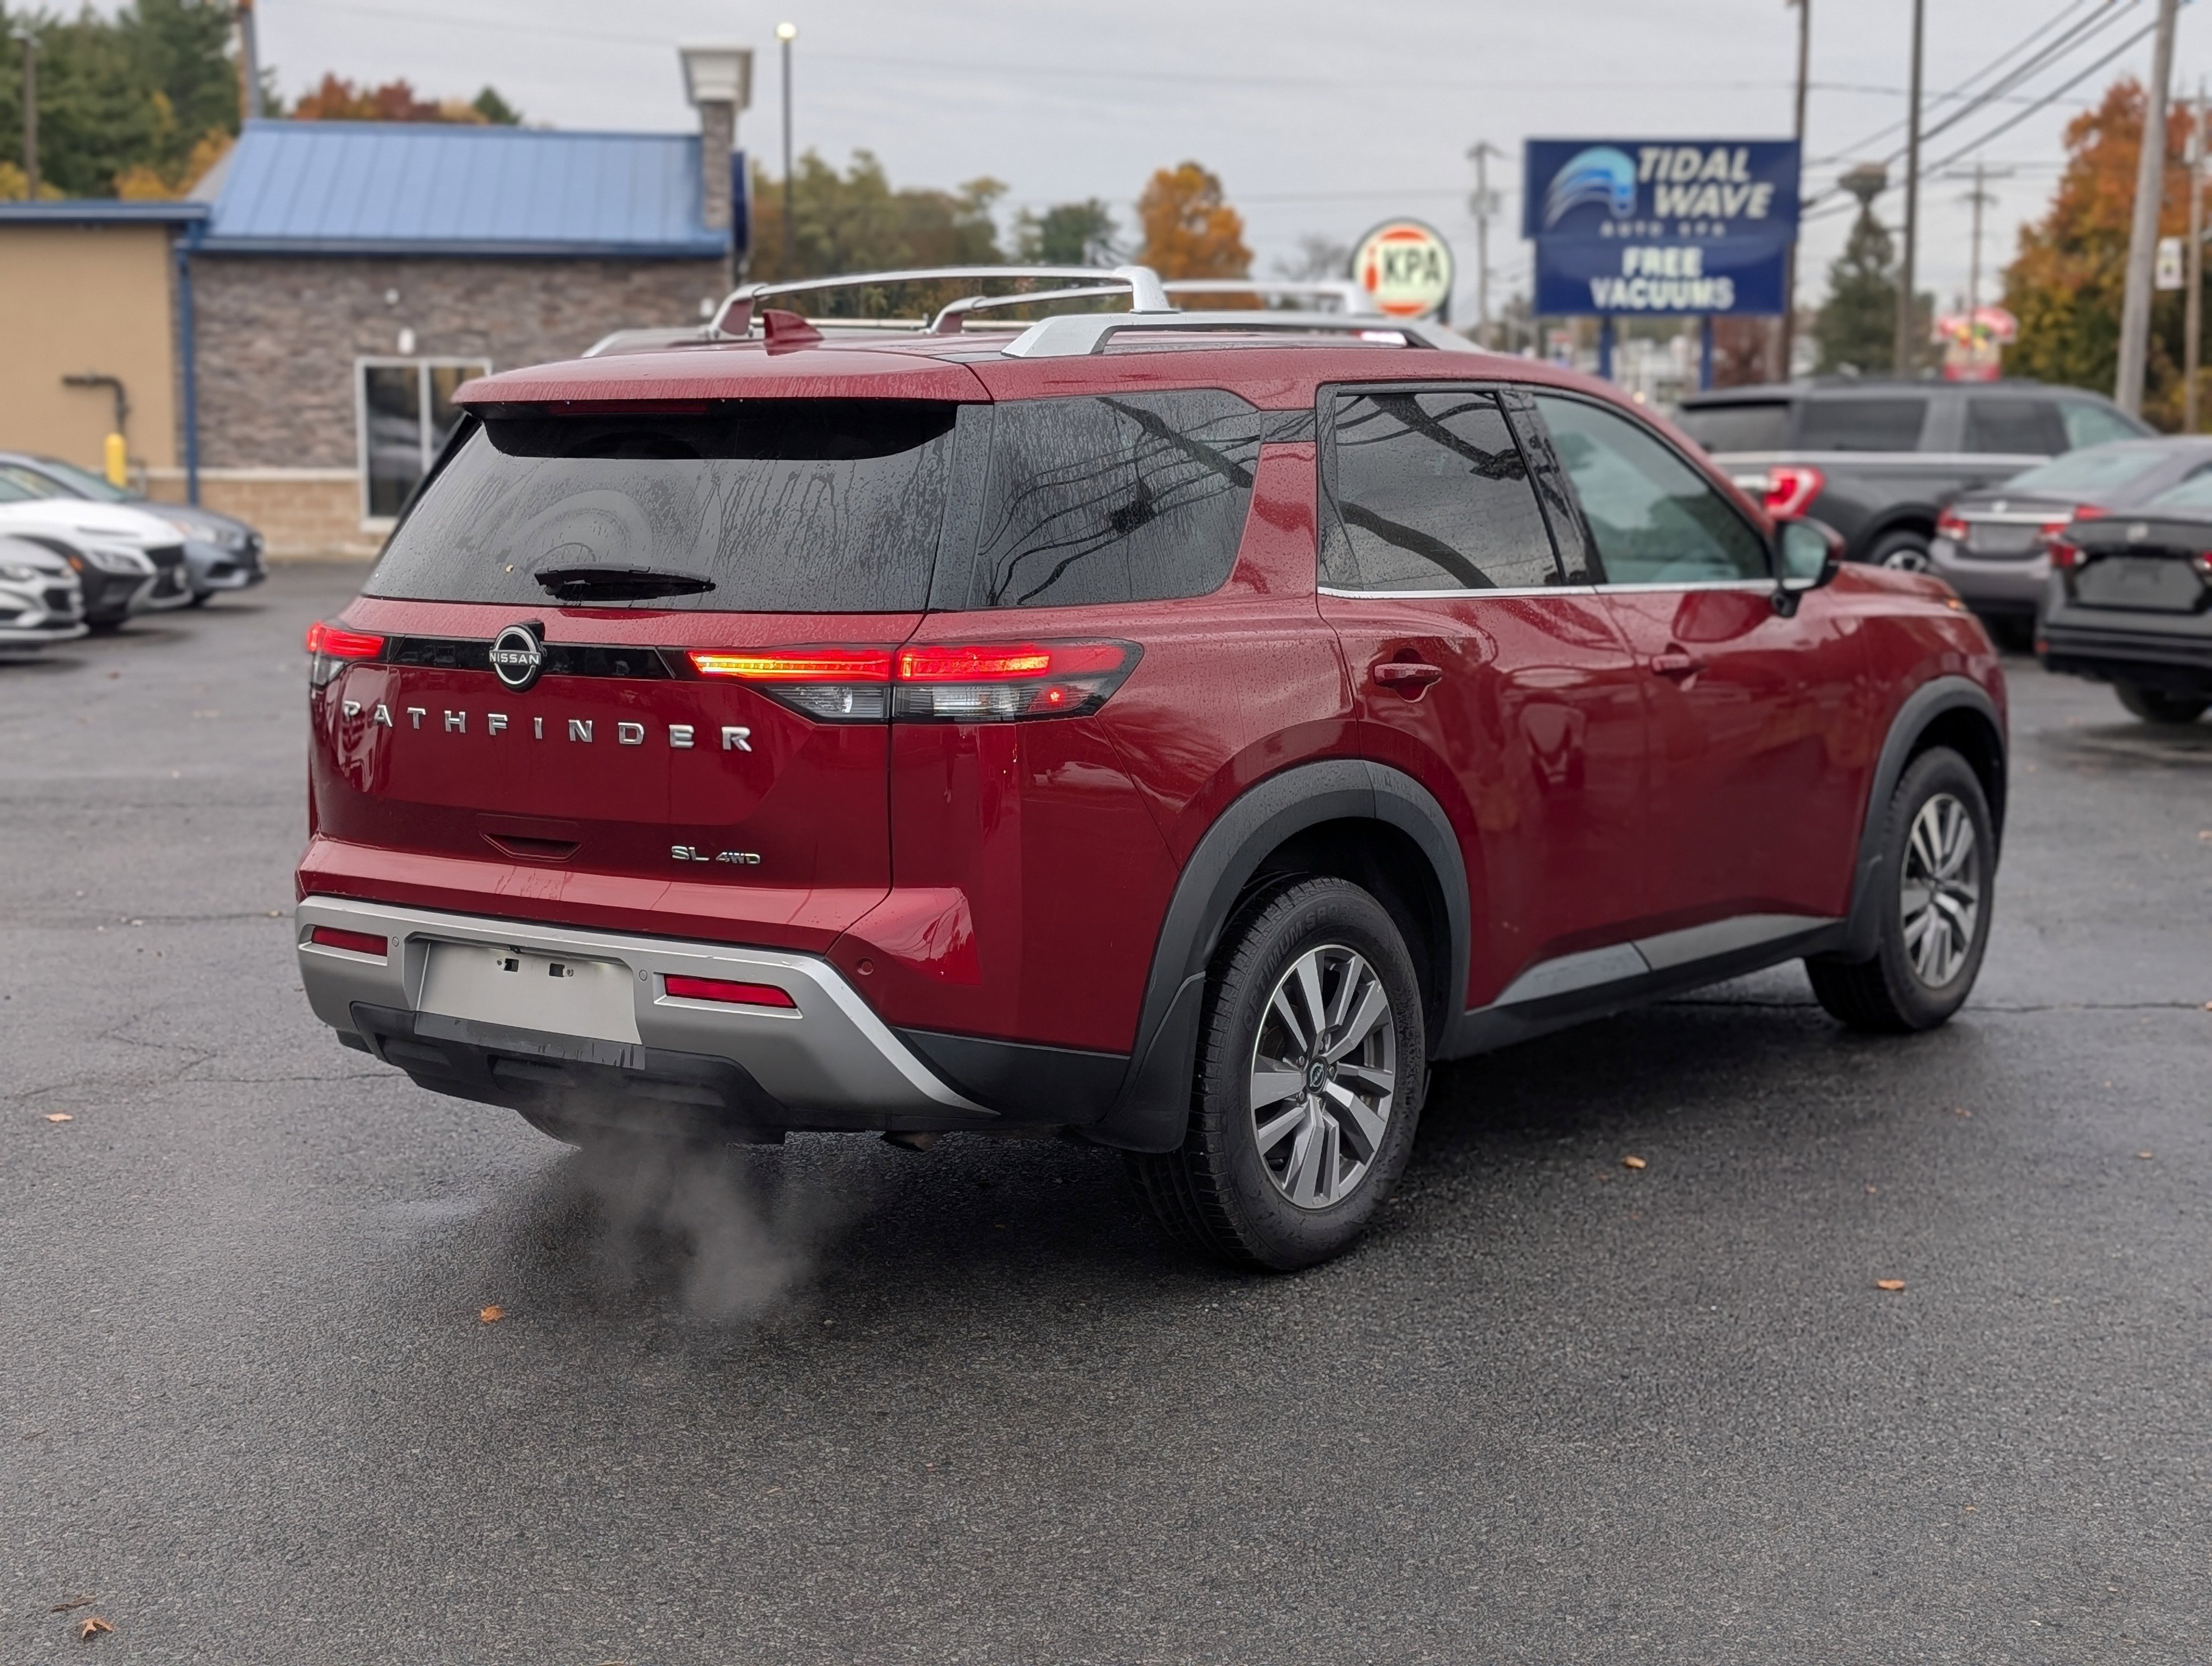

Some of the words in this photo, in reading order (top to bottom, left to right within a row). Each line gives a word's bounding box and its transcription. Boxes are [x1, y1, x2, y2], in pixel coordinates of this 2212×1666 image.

[1638, 148, 1751, 183] TIDAL
[1654, 183, 1774, 218] WAVE
[1622, 247, 1703, 277] FREE
[1589, 277, 1735, 310] VACUUMS
[489, 652, 539, 664] NISSAN
[343, 700, 753, 752] PATHFINDER
[671, 845, 710, 861] SL
[715, 852, 760, 864] 4WD
